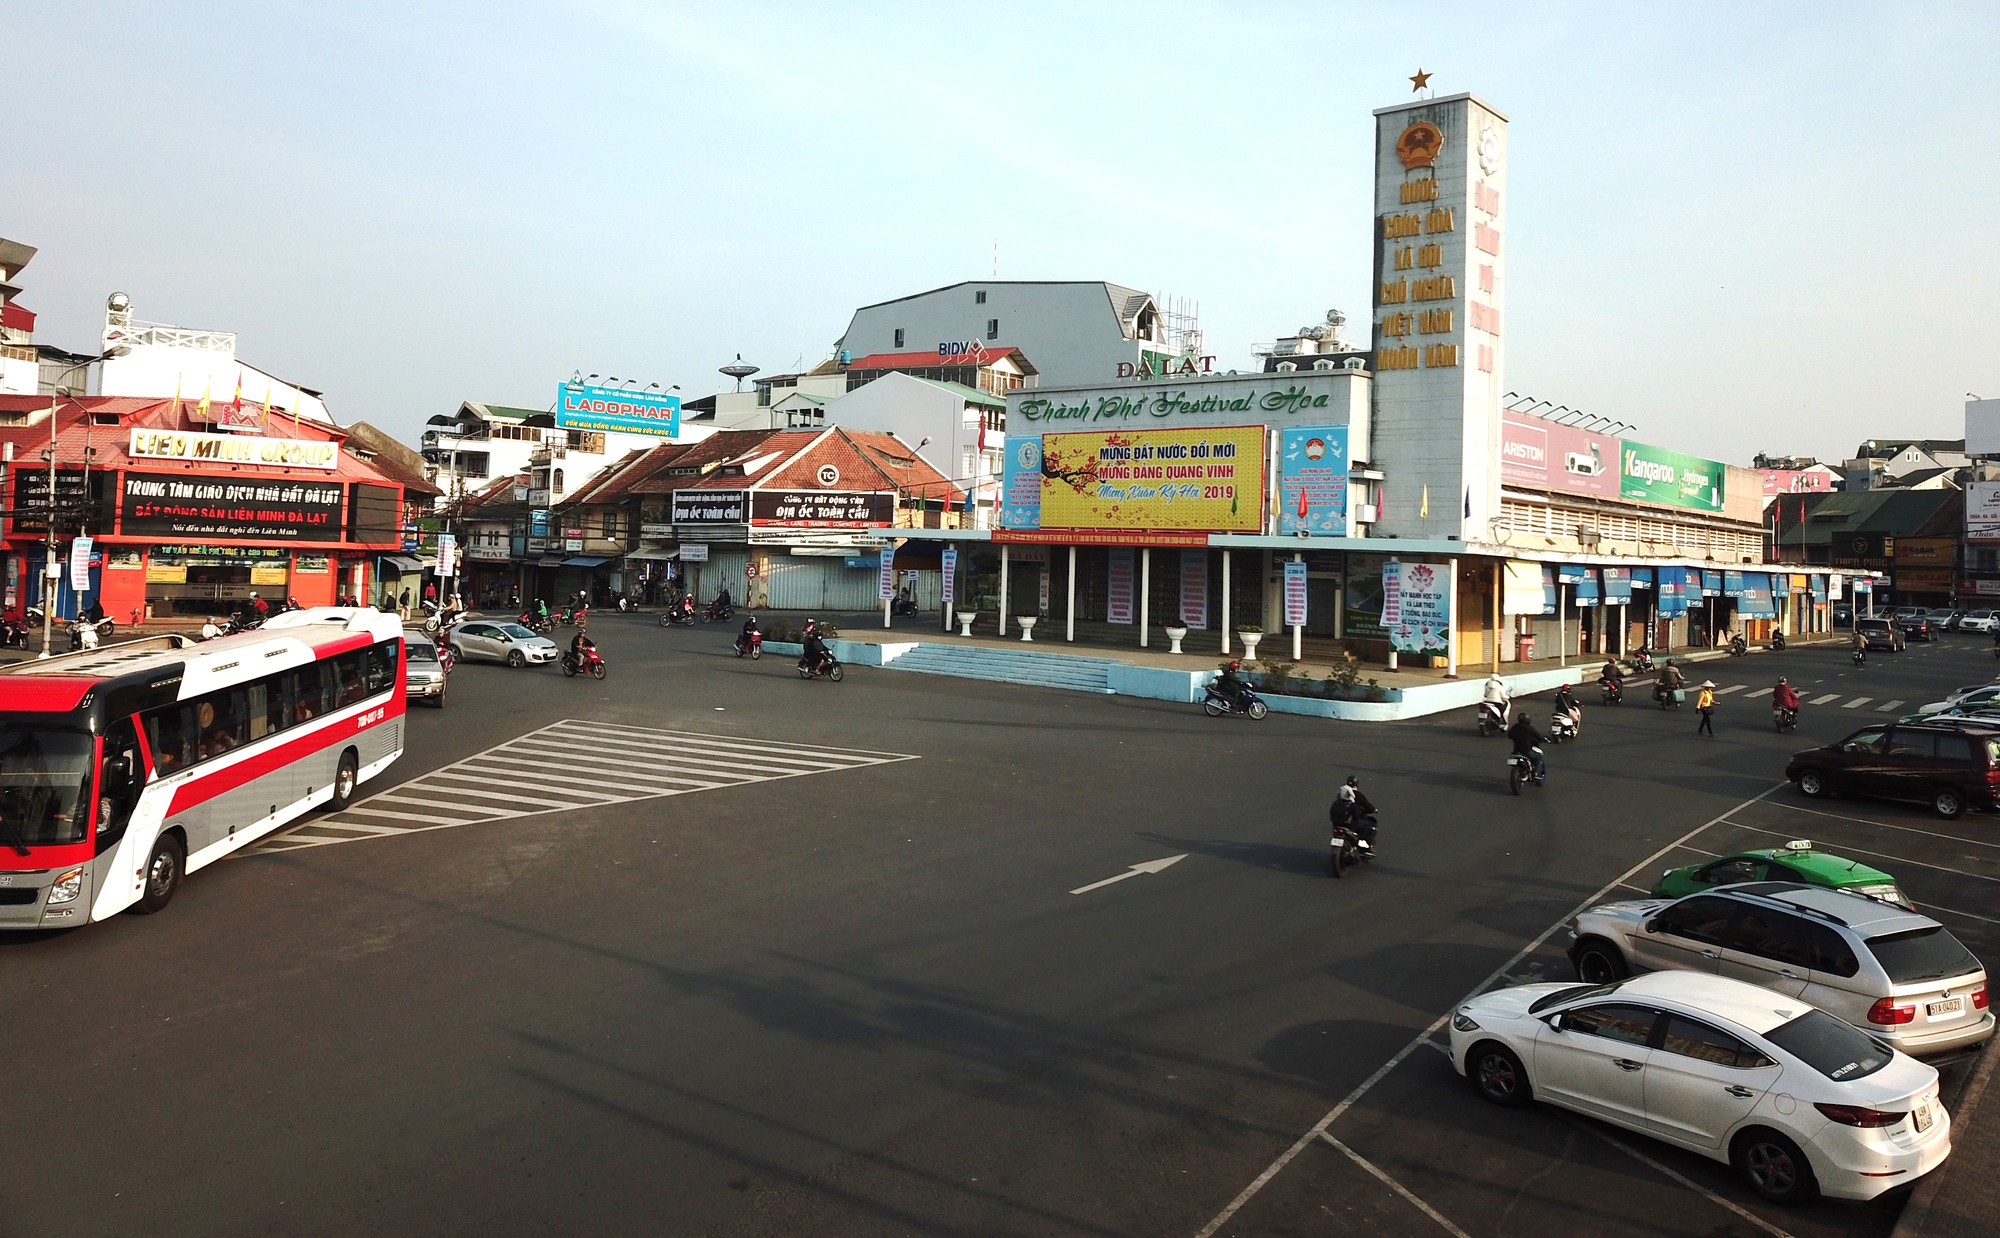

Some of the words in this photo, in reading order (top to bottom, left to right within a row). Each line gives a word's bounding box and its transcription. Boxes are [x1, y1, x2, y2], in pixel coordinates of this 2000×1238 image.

[1401, 177, 1438, 204] NƯỚC
[1384, 214, 1420, 243] CỘNG
[1395, 245, 1413, 272] XÃ
[1418, 243, 1442, 272] HỘI
[1381, 275, 1408, 305] CHỦ
[1413, 275, 1455, 301] NGHĨA
[1382, 312, 1412, 340] VIỆT
[1420, 311, 1452, 334] NAM
[938, 341, 970, 356] BIDV
[1377, 344, 1419, 370] MUÔN
[1425, 343, 1458, 368] NĂM
[1116, 355, 1154, 378] ĐÀ
[565, 396, 672, 420] LADOPHAR
[1019, 398, 1093, 424] Thành
[1093, 396, 1148, 422] Phố
[1150, 390, 1255, 417] Festival
[1260, 386, 1330, 414] Hoa
[192, 438, 254, 460] MINH
[261, 442, 334, 465] GROUP
[1100, 446, 1131, 460] MỪNG
[1133, 442, 1154, 460] ĐẤT
[1157, 444, 1187, 459] NƯỚC
[1190, 440, 1210, 458] ĐỔI
[1213, 443, 1235, 458] MỚI
[1503, 441, 1544, 461] ARISTON
[822, 472, 834, 480] TC
[1099, 465, 1131, 479] MỪNG
[1133, 463, 1162, 479] ĐẢNG
[1166, 465, 1203, 479] QUANG
[1207, 465, 1234, 478] VINH
[1625, 450, 1674, 485] Kangaroo
[126, 480, 165, 497] TRUNG
[169, 481, 193, 499] TÂM
[1204, 486, 1233, 499] 2019
[200, 504, 225, 519] SẢN
[228, 506, 254, 520] LIÊN
[257, 510, 286, 522] MINH
[288, 510, 304, 523] ĐÀ
[307, 512, 328, 526] LẠT
[690, 505, 701, 519] ỐC
[702, 506, 723, 519] TOÀN
[776, 506, 795, 519] ĐỊA
[798, 504, 813, 518] ỐC
[818, 506, 845, 518] TOÀN
[278, 528, 298, 536] Minh
